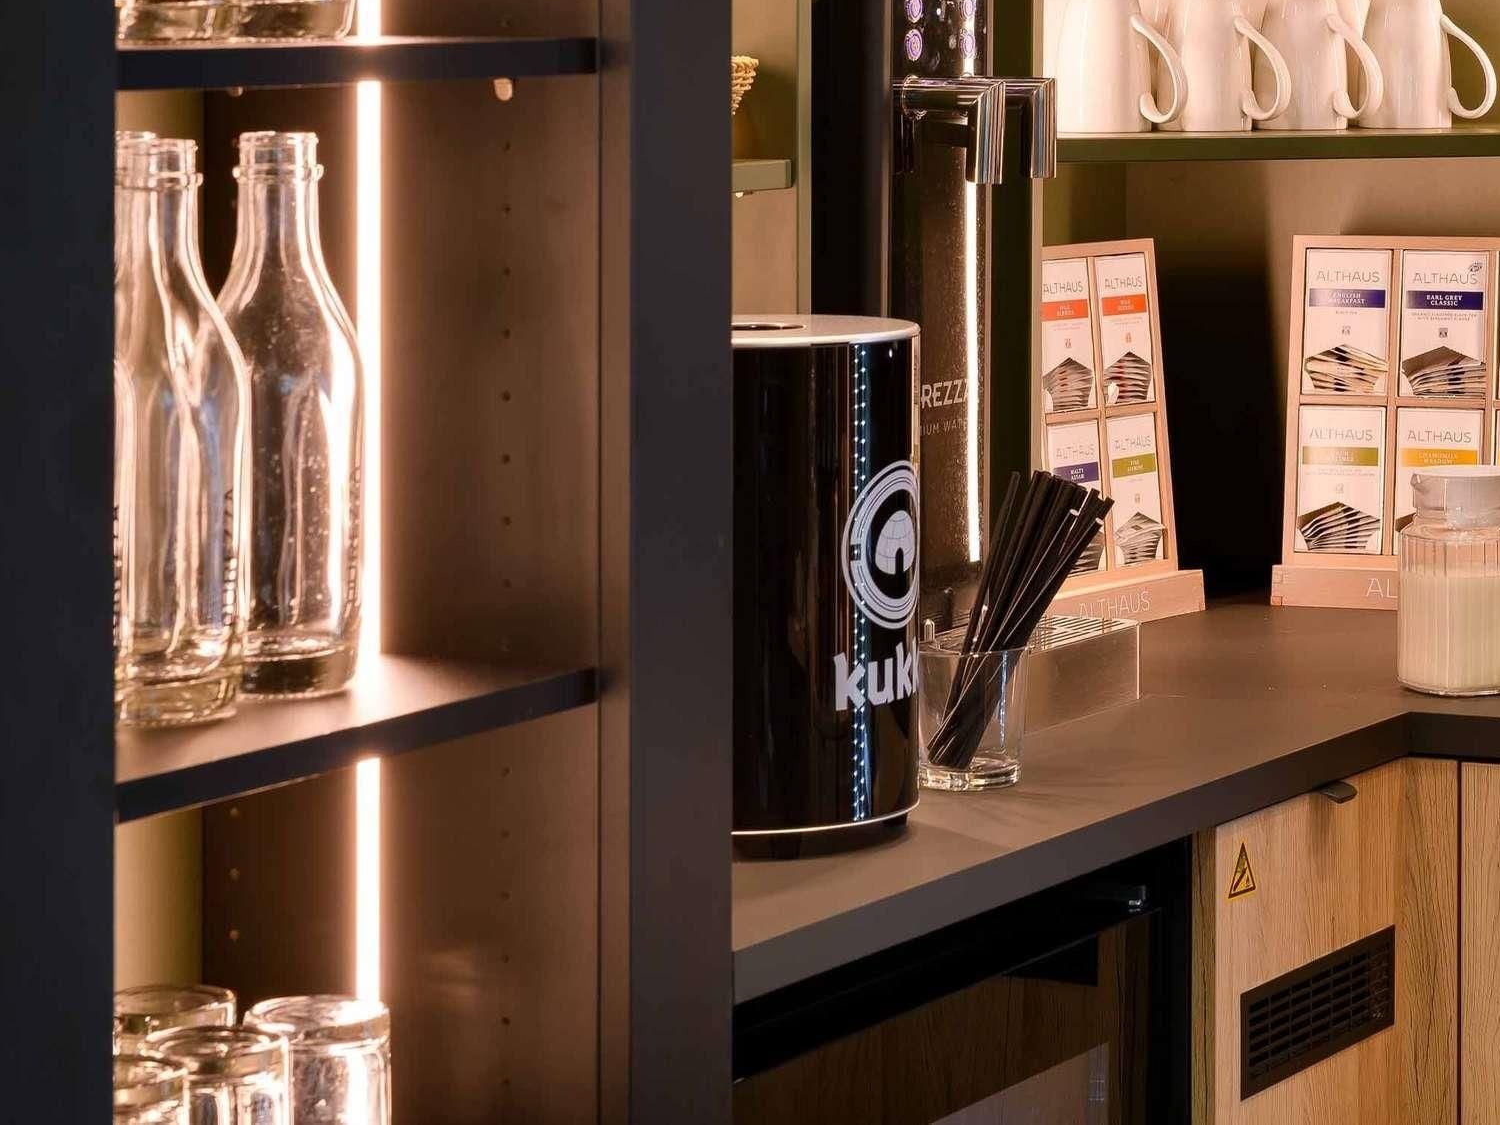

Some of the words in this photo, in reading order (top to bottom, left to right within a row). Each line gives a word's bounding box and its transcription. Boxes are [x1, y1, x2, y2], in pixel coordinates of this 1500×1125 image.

[1104, 276, 1142, 289] ALTHAUS
[1315, 270, 1381, 283] ALTHAUS
[1412, 272, 1479, 285] ALTHAUS
[1042, 281, 1084, 294] ALTHAUS
[1309, 427, 1374, 441] ALTHAUS
[1407, 429, 1472, 443] ALTHAUS
[1079, 590, 1151, 618] ALTHAUS
